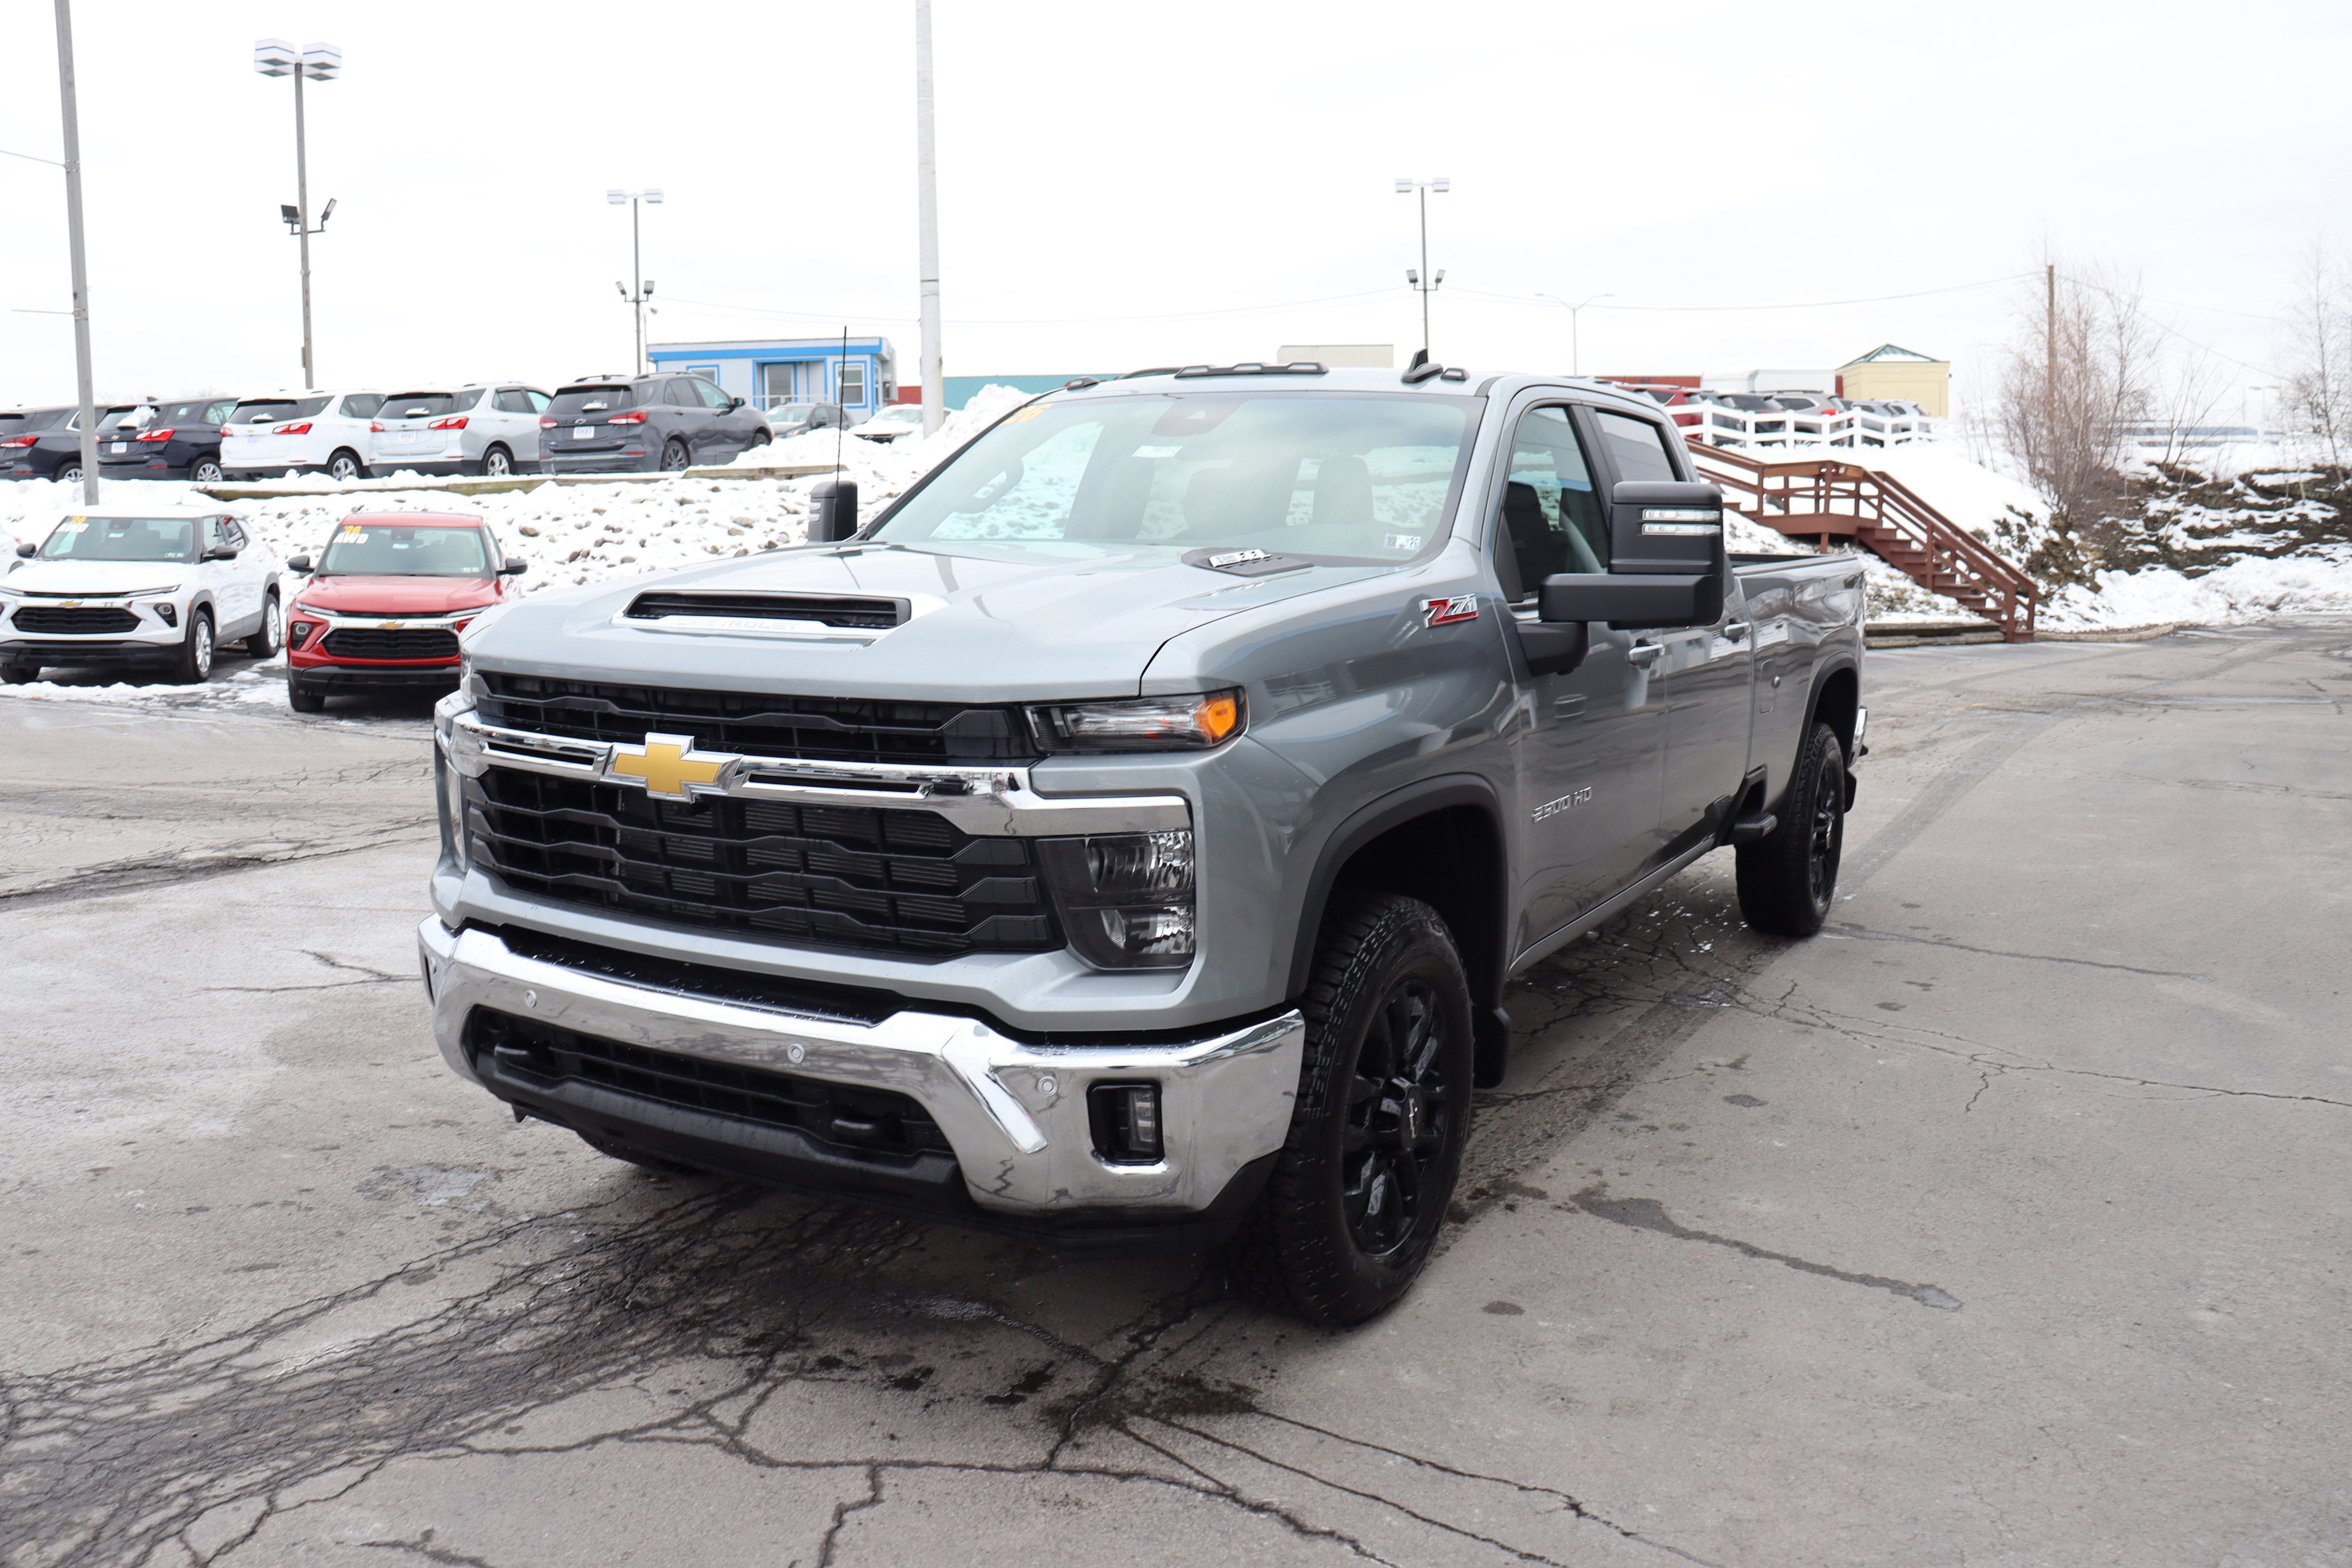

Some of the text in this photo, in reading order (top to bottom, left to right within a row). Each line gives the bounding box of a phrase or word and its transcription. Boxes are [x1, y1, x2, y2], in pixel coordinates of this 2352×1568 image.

[55, 523, 89, 532] AWD
[332, 532, 369, 544] AWD
[1419, 593, 1479, 628] Z71
[1532, 786, 1592, 823] 2500 HD
